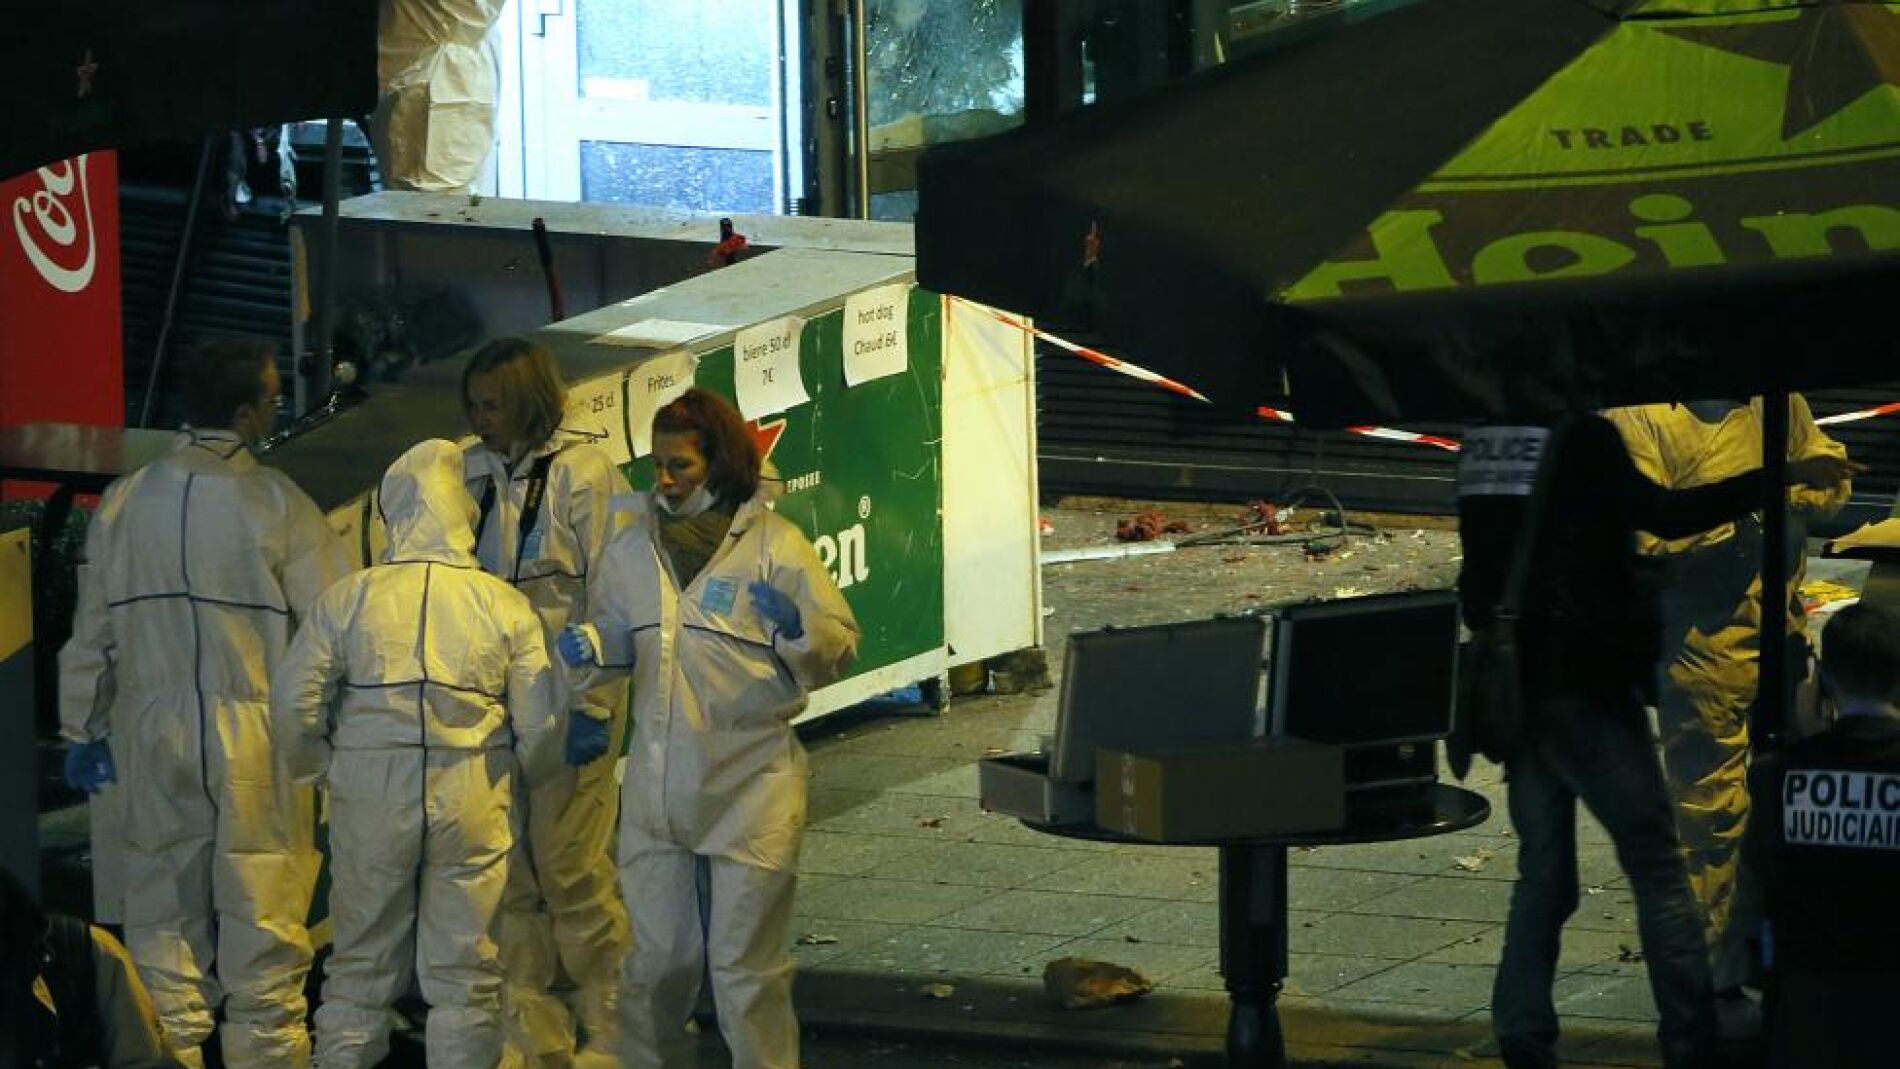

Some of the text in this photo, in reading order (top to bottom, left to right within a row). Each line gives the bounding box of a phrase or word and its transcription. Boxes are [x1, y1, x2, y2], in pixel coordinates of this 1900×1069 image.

[1551, 121, 1713, 152] TRADE
[857, 303, 894, 325] hot dog
[769, 336, 781, 353] 50
[854, 333, 884, 356] Chaud
[1786, 774, 1900, 811] POLIC
